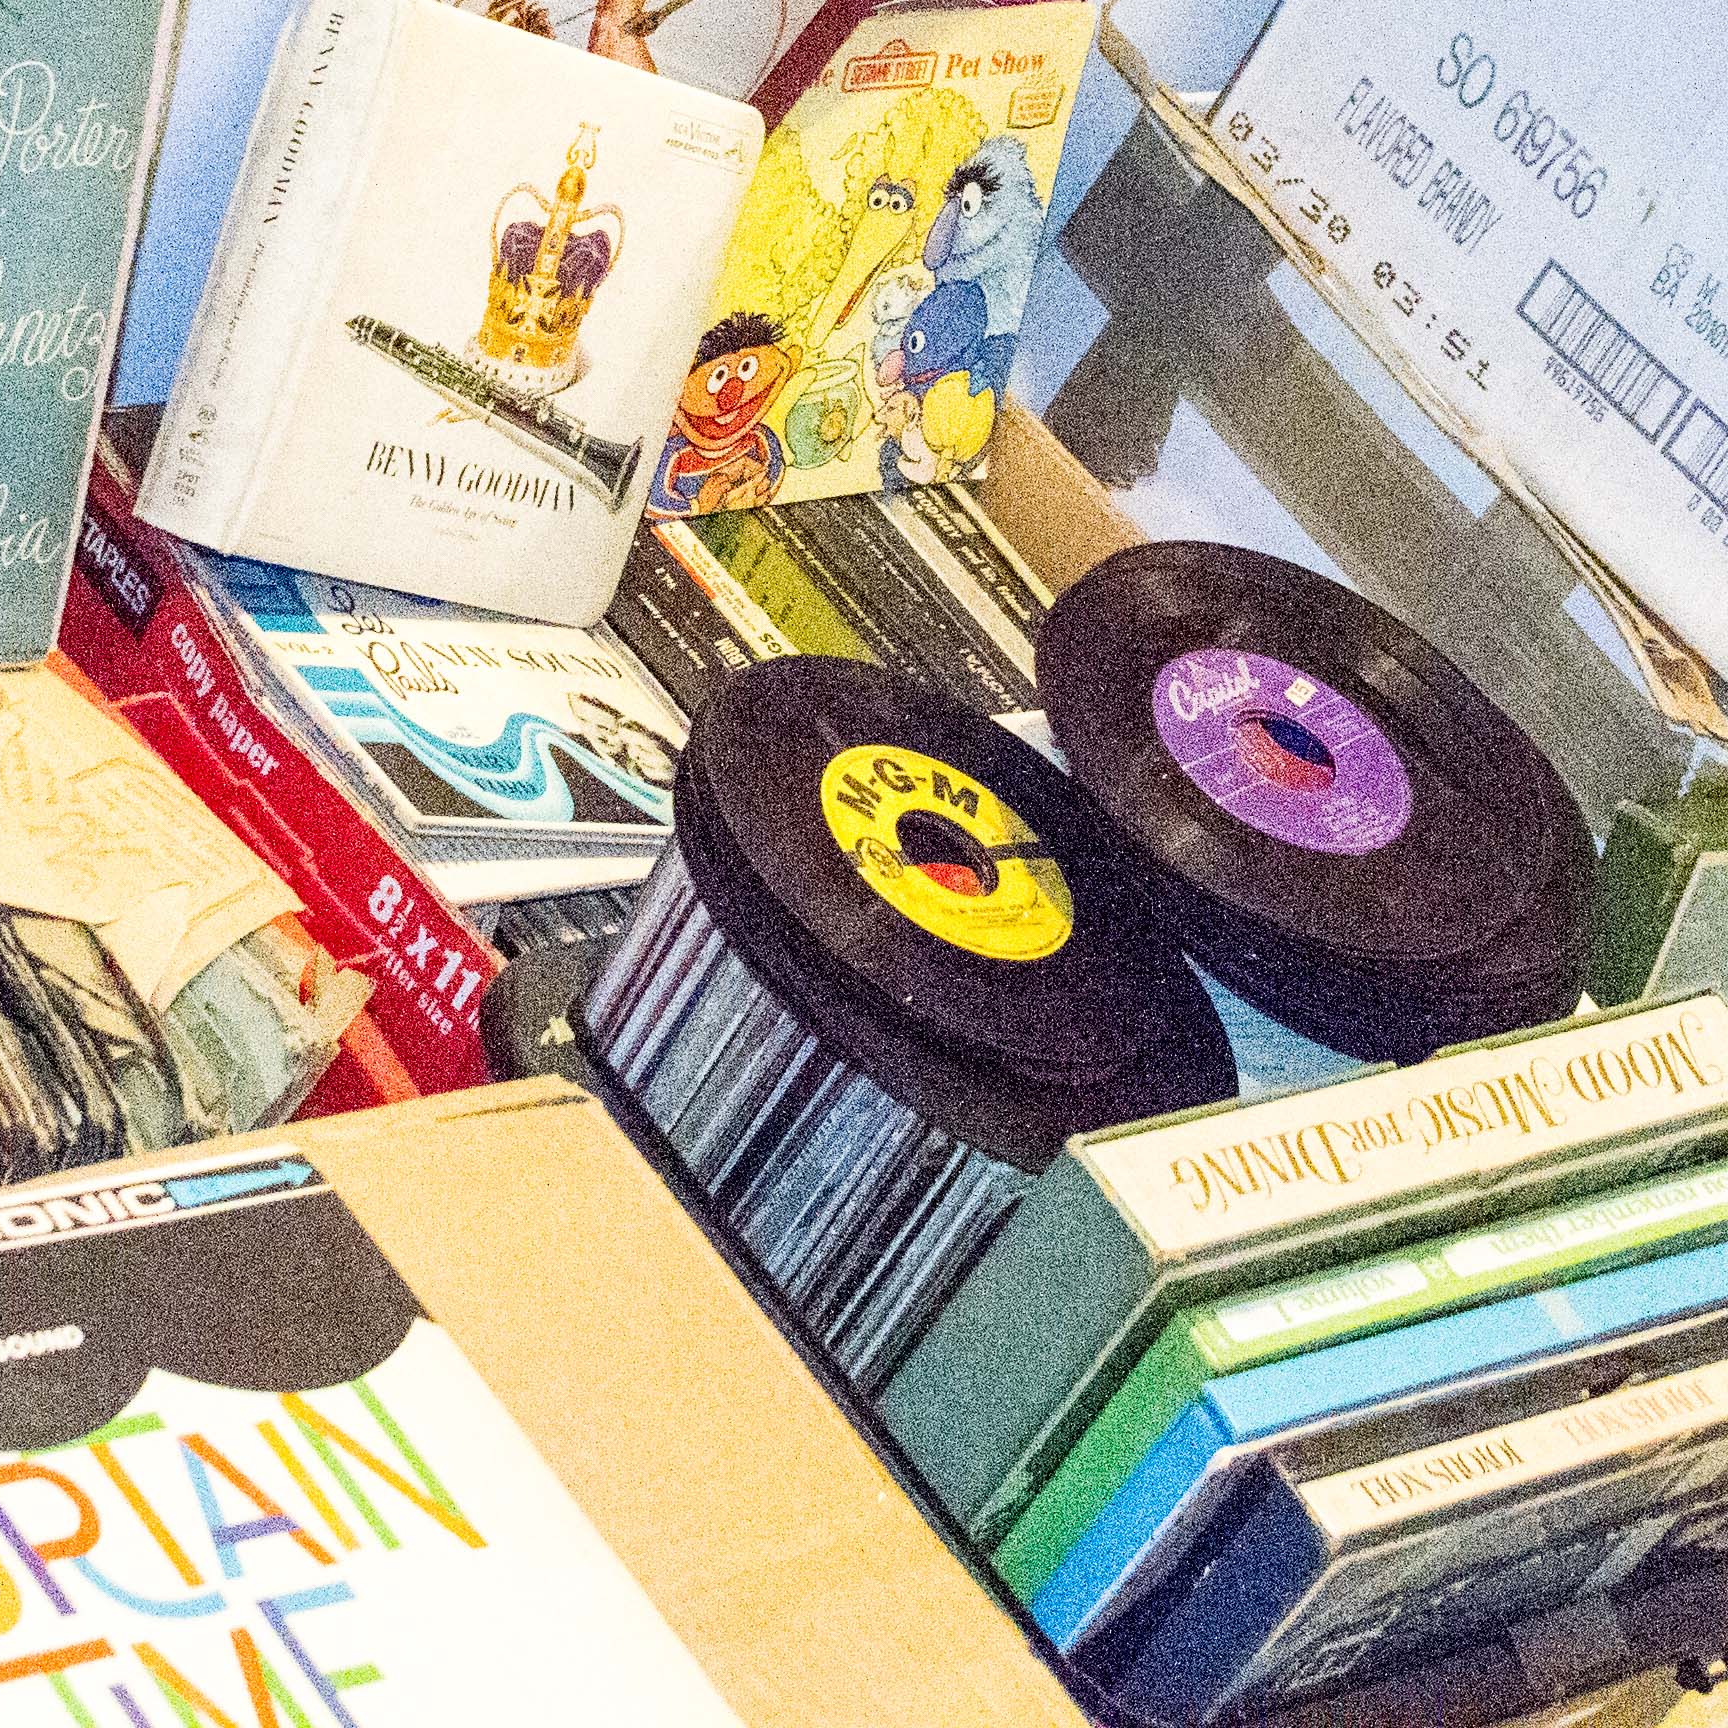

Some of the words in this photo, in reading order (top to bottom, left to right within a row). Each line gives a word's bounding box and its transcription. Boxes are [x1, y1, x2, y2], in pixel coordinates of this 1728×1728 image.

[943, 51, 981, 80] Pet
[987, 49, 1046, 78] Show
[1335, 77, 1435, 190] FLAVORED
[1424, 156, 1503, 253] BRANDY
[1436, 32, 1496, 109] SO
[1494, 88, 1608, 220] 619756
[366, 440, 446, 487] BENNY
[457, 463, 575, 511] GOODMAN
[170, 623, 217, 699] copy
[208, 699, 280, 779] paper
[419, 640, 501, 673] NEW
[506, 648, 623, 682] SOUND
[956, 643, 1021, 716] HOMA!
[415, 988, 454, 1037] size
[434, 949, 479, 1012] 11
[1564, 1010, 1708, 1104] MOOD
[1396, 1060, 1569, 1154] MUSIC
[1168, 1123, 1352, 1212] DINING
